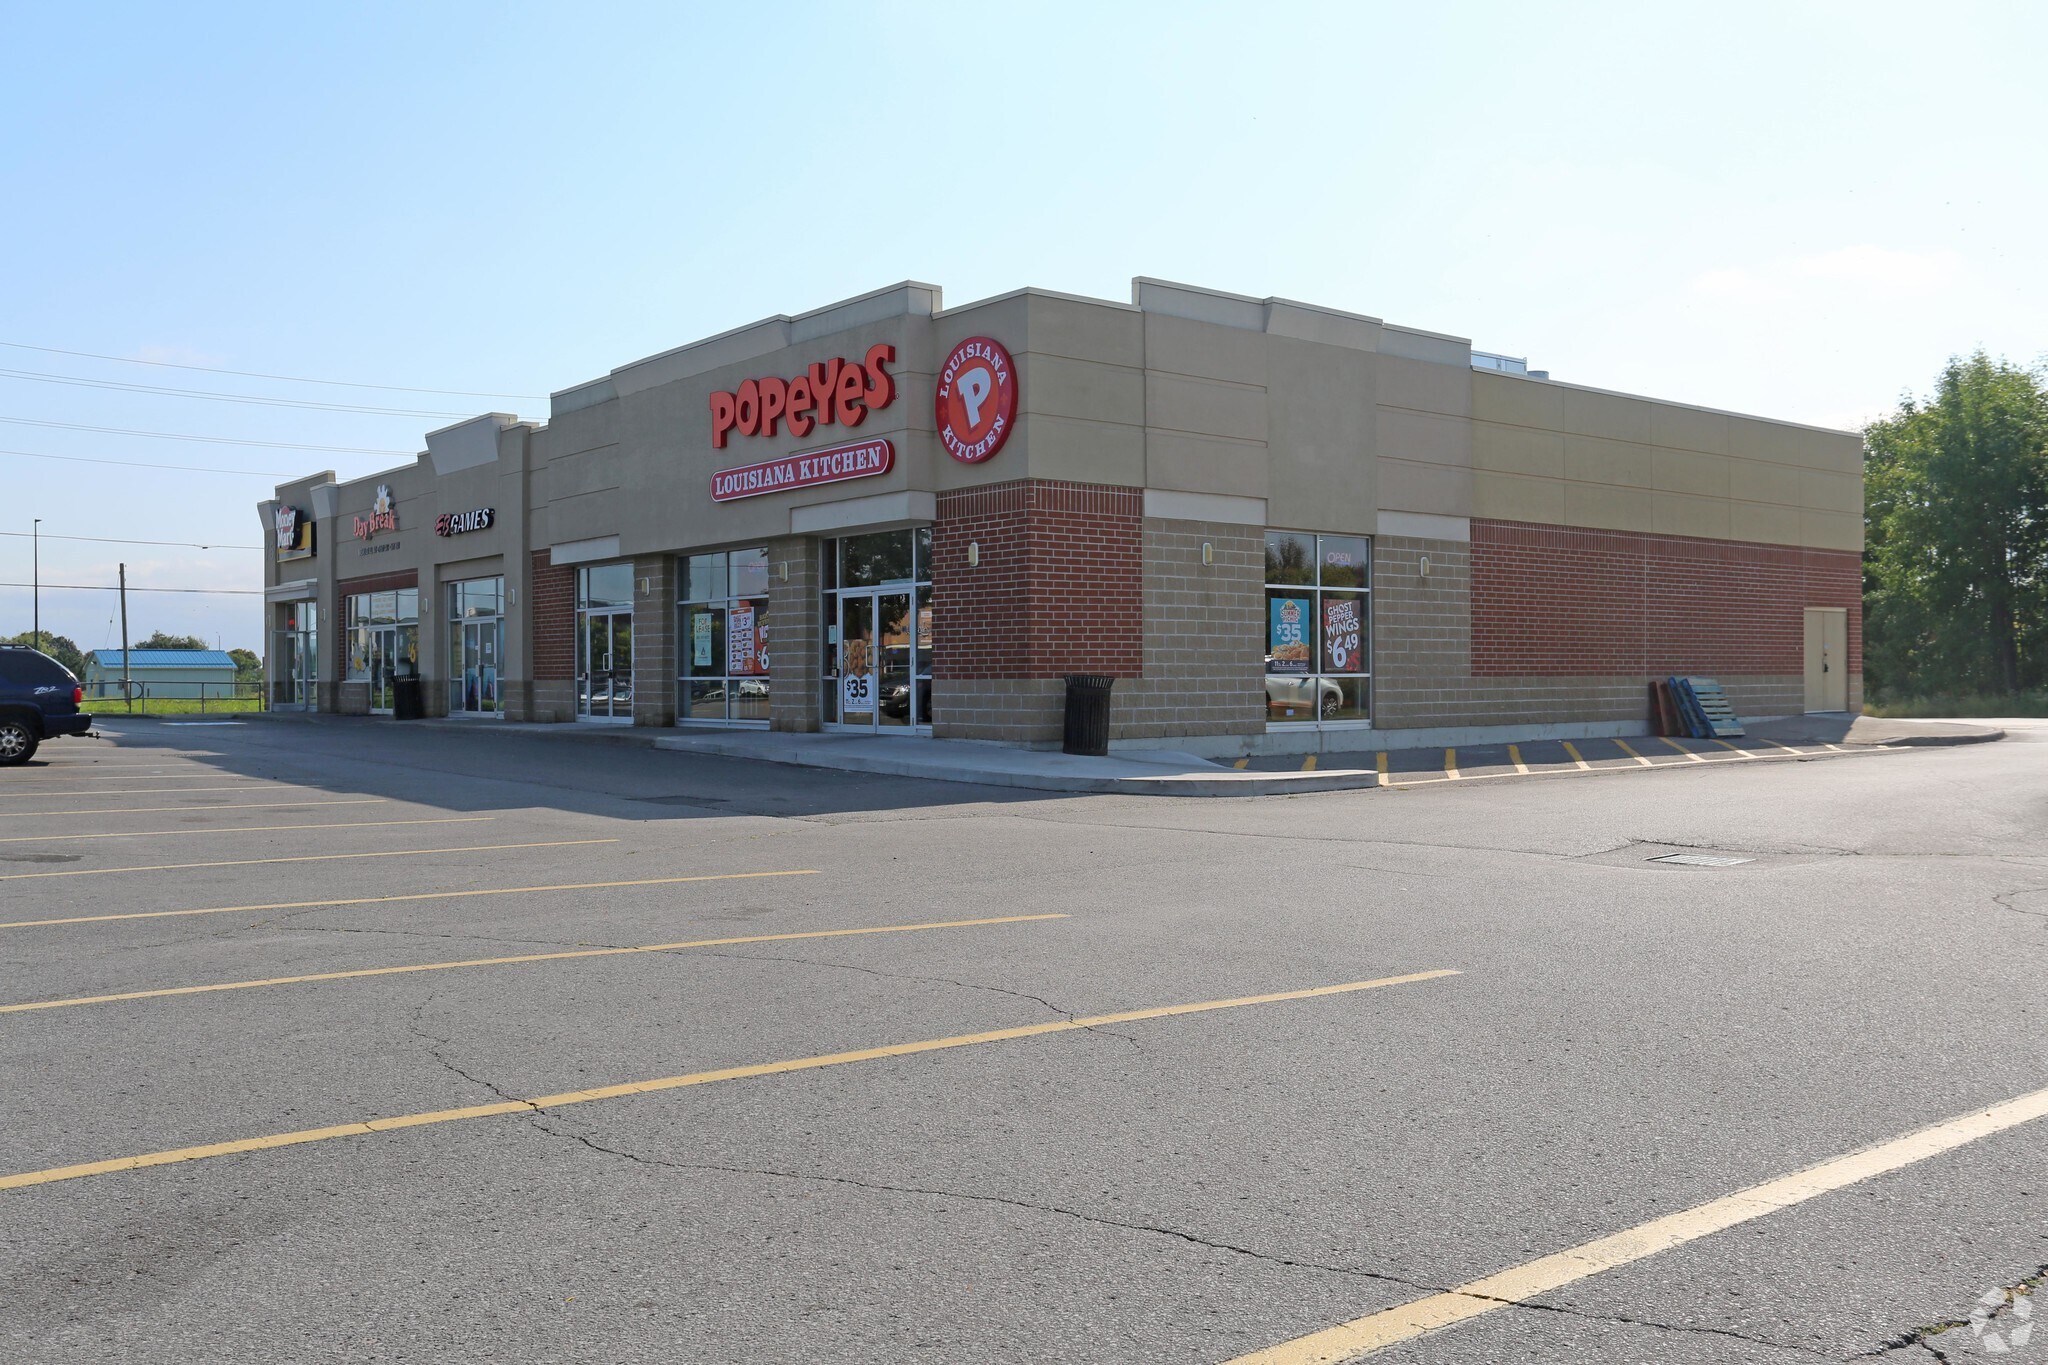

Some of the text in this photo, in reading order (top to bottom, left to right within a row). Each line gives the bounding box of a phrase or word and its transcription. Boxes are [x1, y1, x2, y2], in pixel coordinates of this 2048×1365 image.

[938, 341, 1007, 400] LOUISIANA
[955, 366, 992, 429] P
[941, 413, 1006, 459] KITCHEN
[714, 445, 882, 496] LOUISIANA KITCHEN
[275, 508, 296, 532] Money
[353, 508, 396, 541] Day Break
[1327, 551, 1352, 564] OPEN
[1327, 601, 1353, 616] GHOST
[1328, 610, 1354, 624] PEPPER
[1276, 623, 1302, 642] $35
[1325, 617, 1360, 638] WINGS
[846, 678, 868, 698] $35
